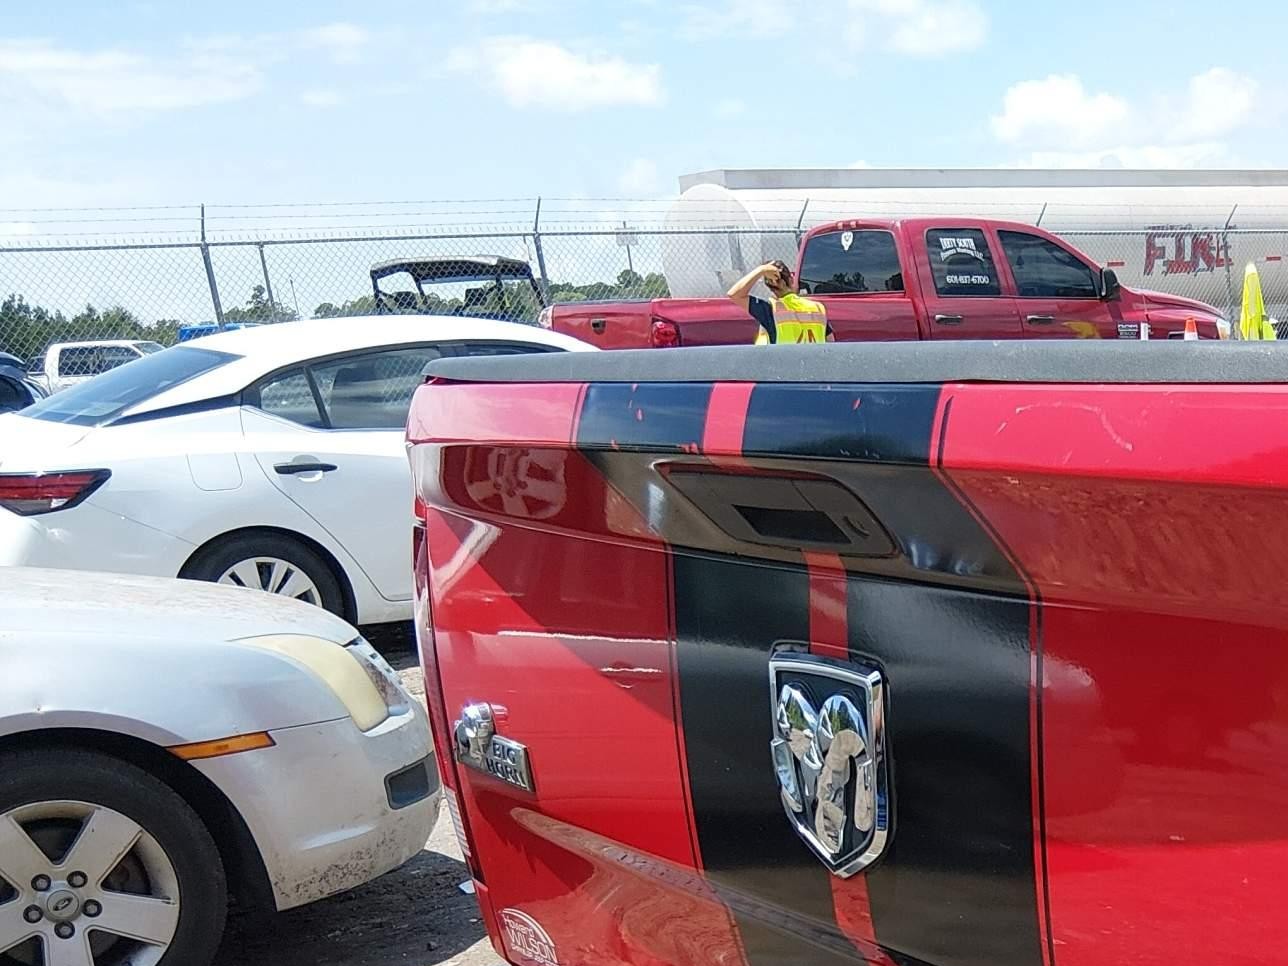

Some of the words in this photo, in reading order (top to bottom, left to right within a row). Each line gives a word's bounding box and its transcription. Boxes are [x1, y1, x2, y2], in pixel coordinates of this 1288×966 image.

[493, 742, 517, 765] BIG
[486, 757, 528, 787] HORN
[505, 926, 559, 964] WILSON
